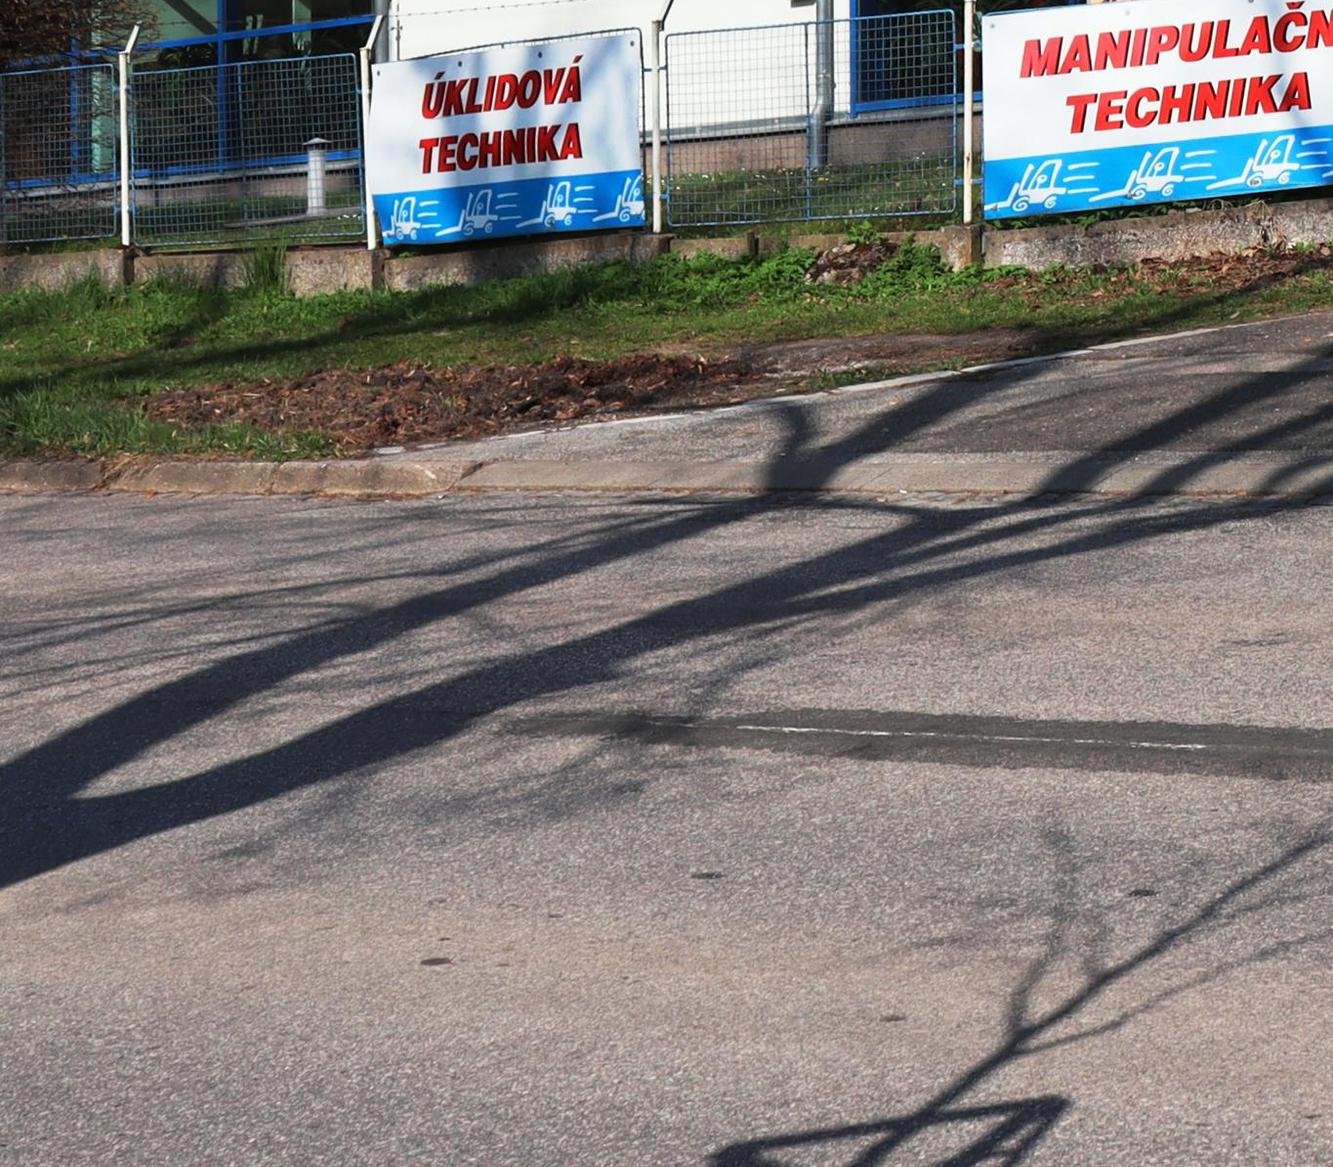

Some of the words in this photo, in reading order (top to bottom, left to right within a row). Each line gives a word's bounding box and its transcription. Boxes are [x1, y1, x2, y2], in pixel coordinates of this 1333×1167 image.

[421, 54, 584, 120] ÚKLIDOVÁ
[1066, 71, 1312, 134] TECHNIKA
[419, 123, 583, 174] TECHNIKA
